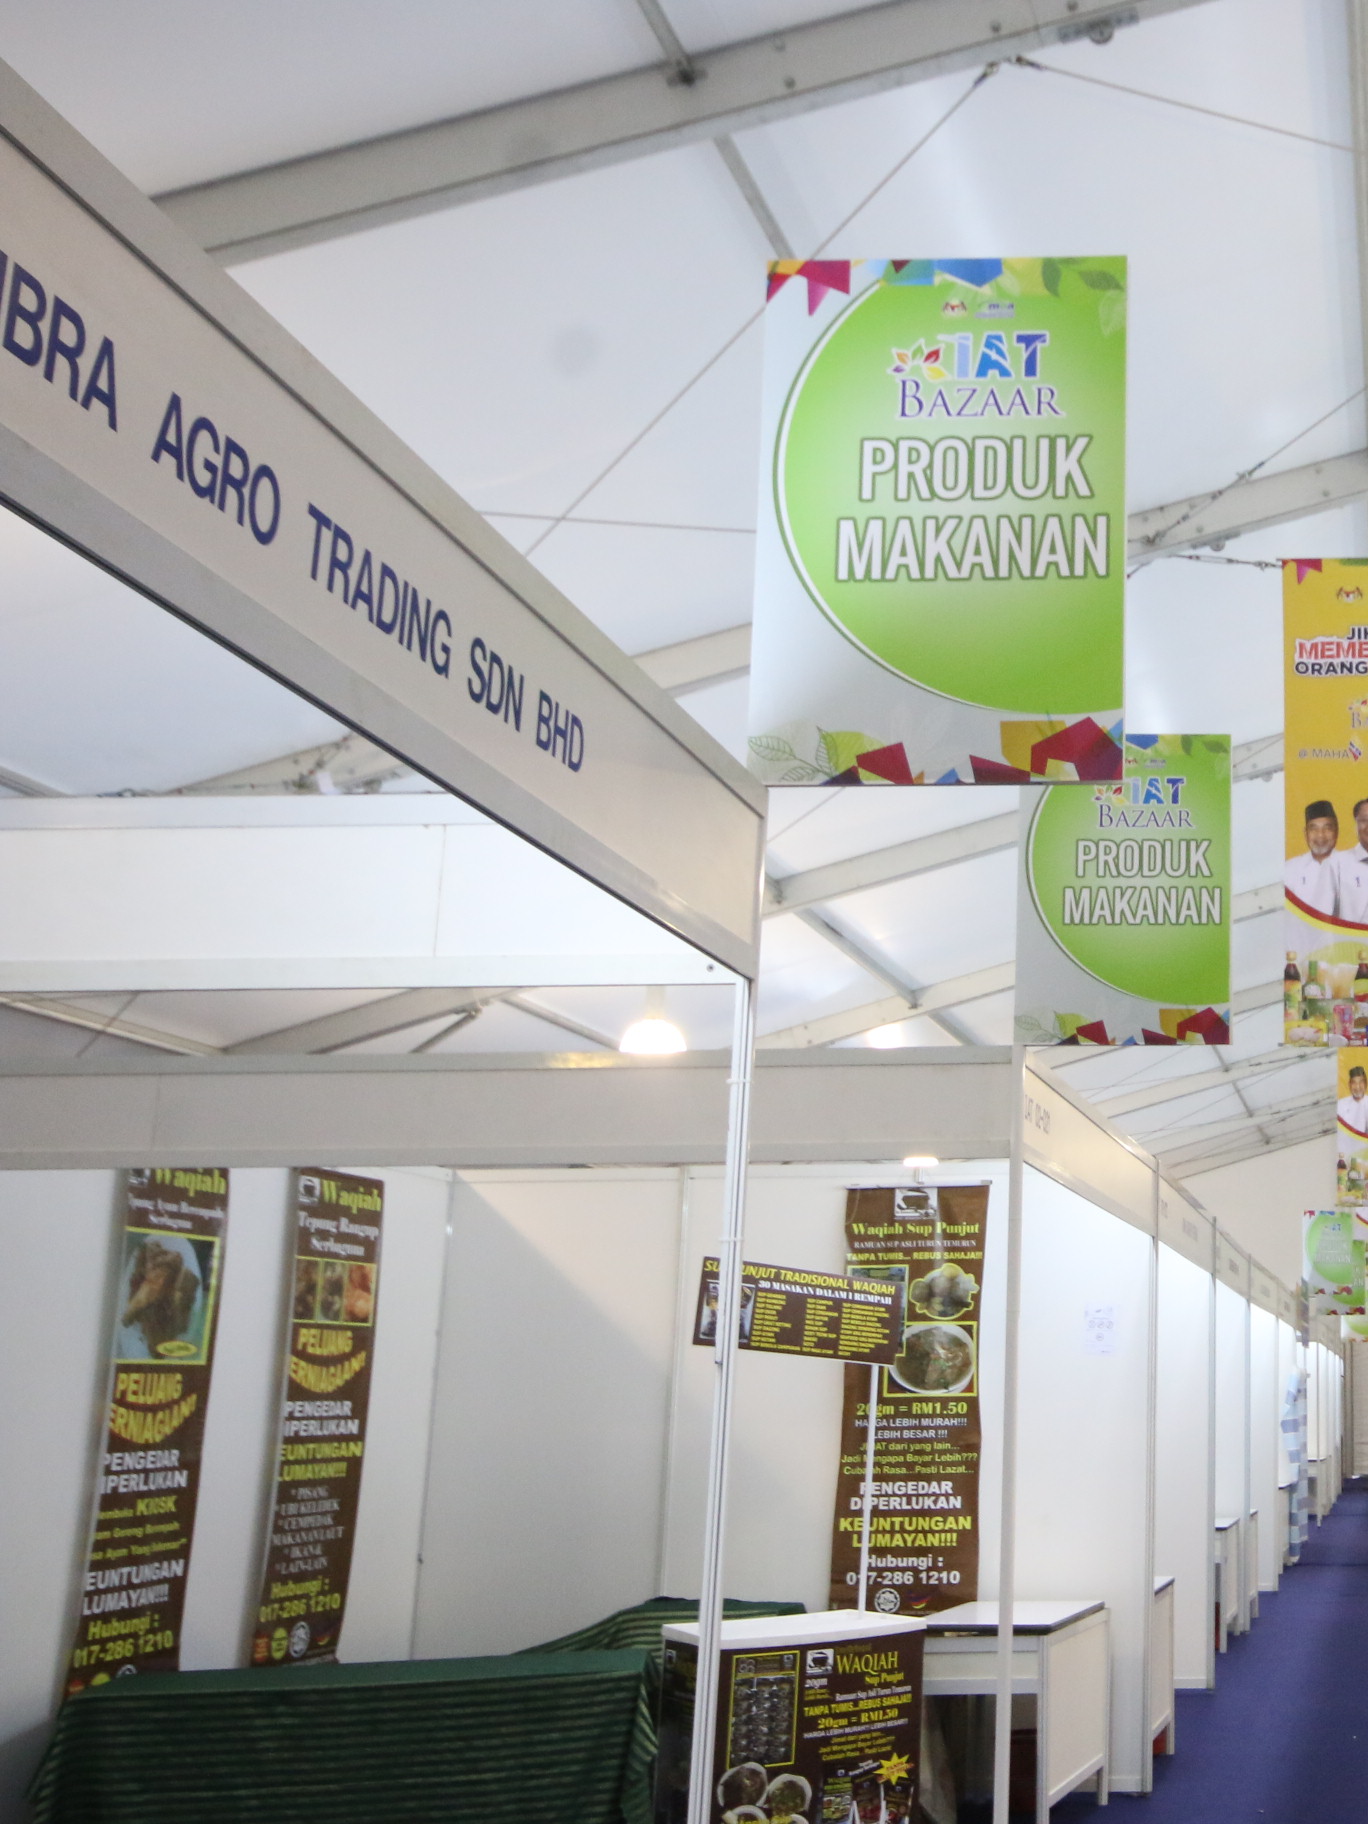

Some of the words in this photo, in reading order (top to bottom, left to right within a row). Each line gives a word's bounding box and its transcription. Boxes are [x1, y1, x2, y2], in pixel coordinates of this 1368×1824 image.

[950, 332, 1048, 378] IAT
[900, 379, 1061, 418] BAZAAR
[859, 434, 1094, 501] PRODUK
[0, 250, 118, 432] BRA
[150, 391, 281, 545] AGRO
[307, 503, 452, 679] TRADING
[467, 638, 524, 732] SDN
[536, 690, 585, 773] BHD
[835, 513, 1110, 582] MAKANAN
[1295, 661, 1368, 675] ORANG
[1130, 777, 1185, 805] IAT
[1099, 804, 1193, 828] BAZAAR
[1076, 838, 1213, 878] PRODUK
[1062, 886, 1222, 925] MAKANAN
[322, 1180, 381, 1214] Waqiah
[852, 1223, 904, 1238] Waqiah
[906, 1222, 932, 1236] Sup
[936, 1222, 980, 1236] Punjut
[741, 1264, 778, 1280] UNJUT
[780, 1270, 850, 1290] TRADISIONAL
[853, 1280, 896, 1295] WAQIAH
[912, 1402, 968, 1415] RM1.50
[284, 1419, 359, 1437] IPERLUKAN
[855, 1418, 888, 1427] HAGA
[890, 1418, 919, 1427] LEBIH
[921, 1417, 967, 1427] MURAH!!!
[874, 1430, 900, 1439] LEBIH
[903, 1430, 936, 1439] BESAR
[281, 1441, 363, 1461] EUNTUNGAN
[841, 1454, 861, 1463] Jadi
[864, 1454, 904, 1464] ngapa
[906, 1453, 933, 1464] Bayar
[935, 1453, 977, 1462] Lebih???
[860, 1442, 886, 1451] JAT
[889, 1442, 907, 1450] dari
[909, 1443, 931, 1452] yang
[100, 1470, 188, 1494] IPERLUKAN
[839, 1516, 972, 1531] KEUNTUNGAN
[867, 1554, 933, 1570] Hubungi
[85, 1559, 185, 1591] EUNTUNGAN
[846, 1571, 914, 1585] 07-286
[919, 1571, 961, 1584] 1210
[310, 1592, 341, 1613] 1210
[87, 1611, 151, 1641] Hubungi
[73, 1638, 134, 1668] 017-286
[138, 1630, 174, 1654] 1210
[836, 1650, 899, 1675] WAQIAH
